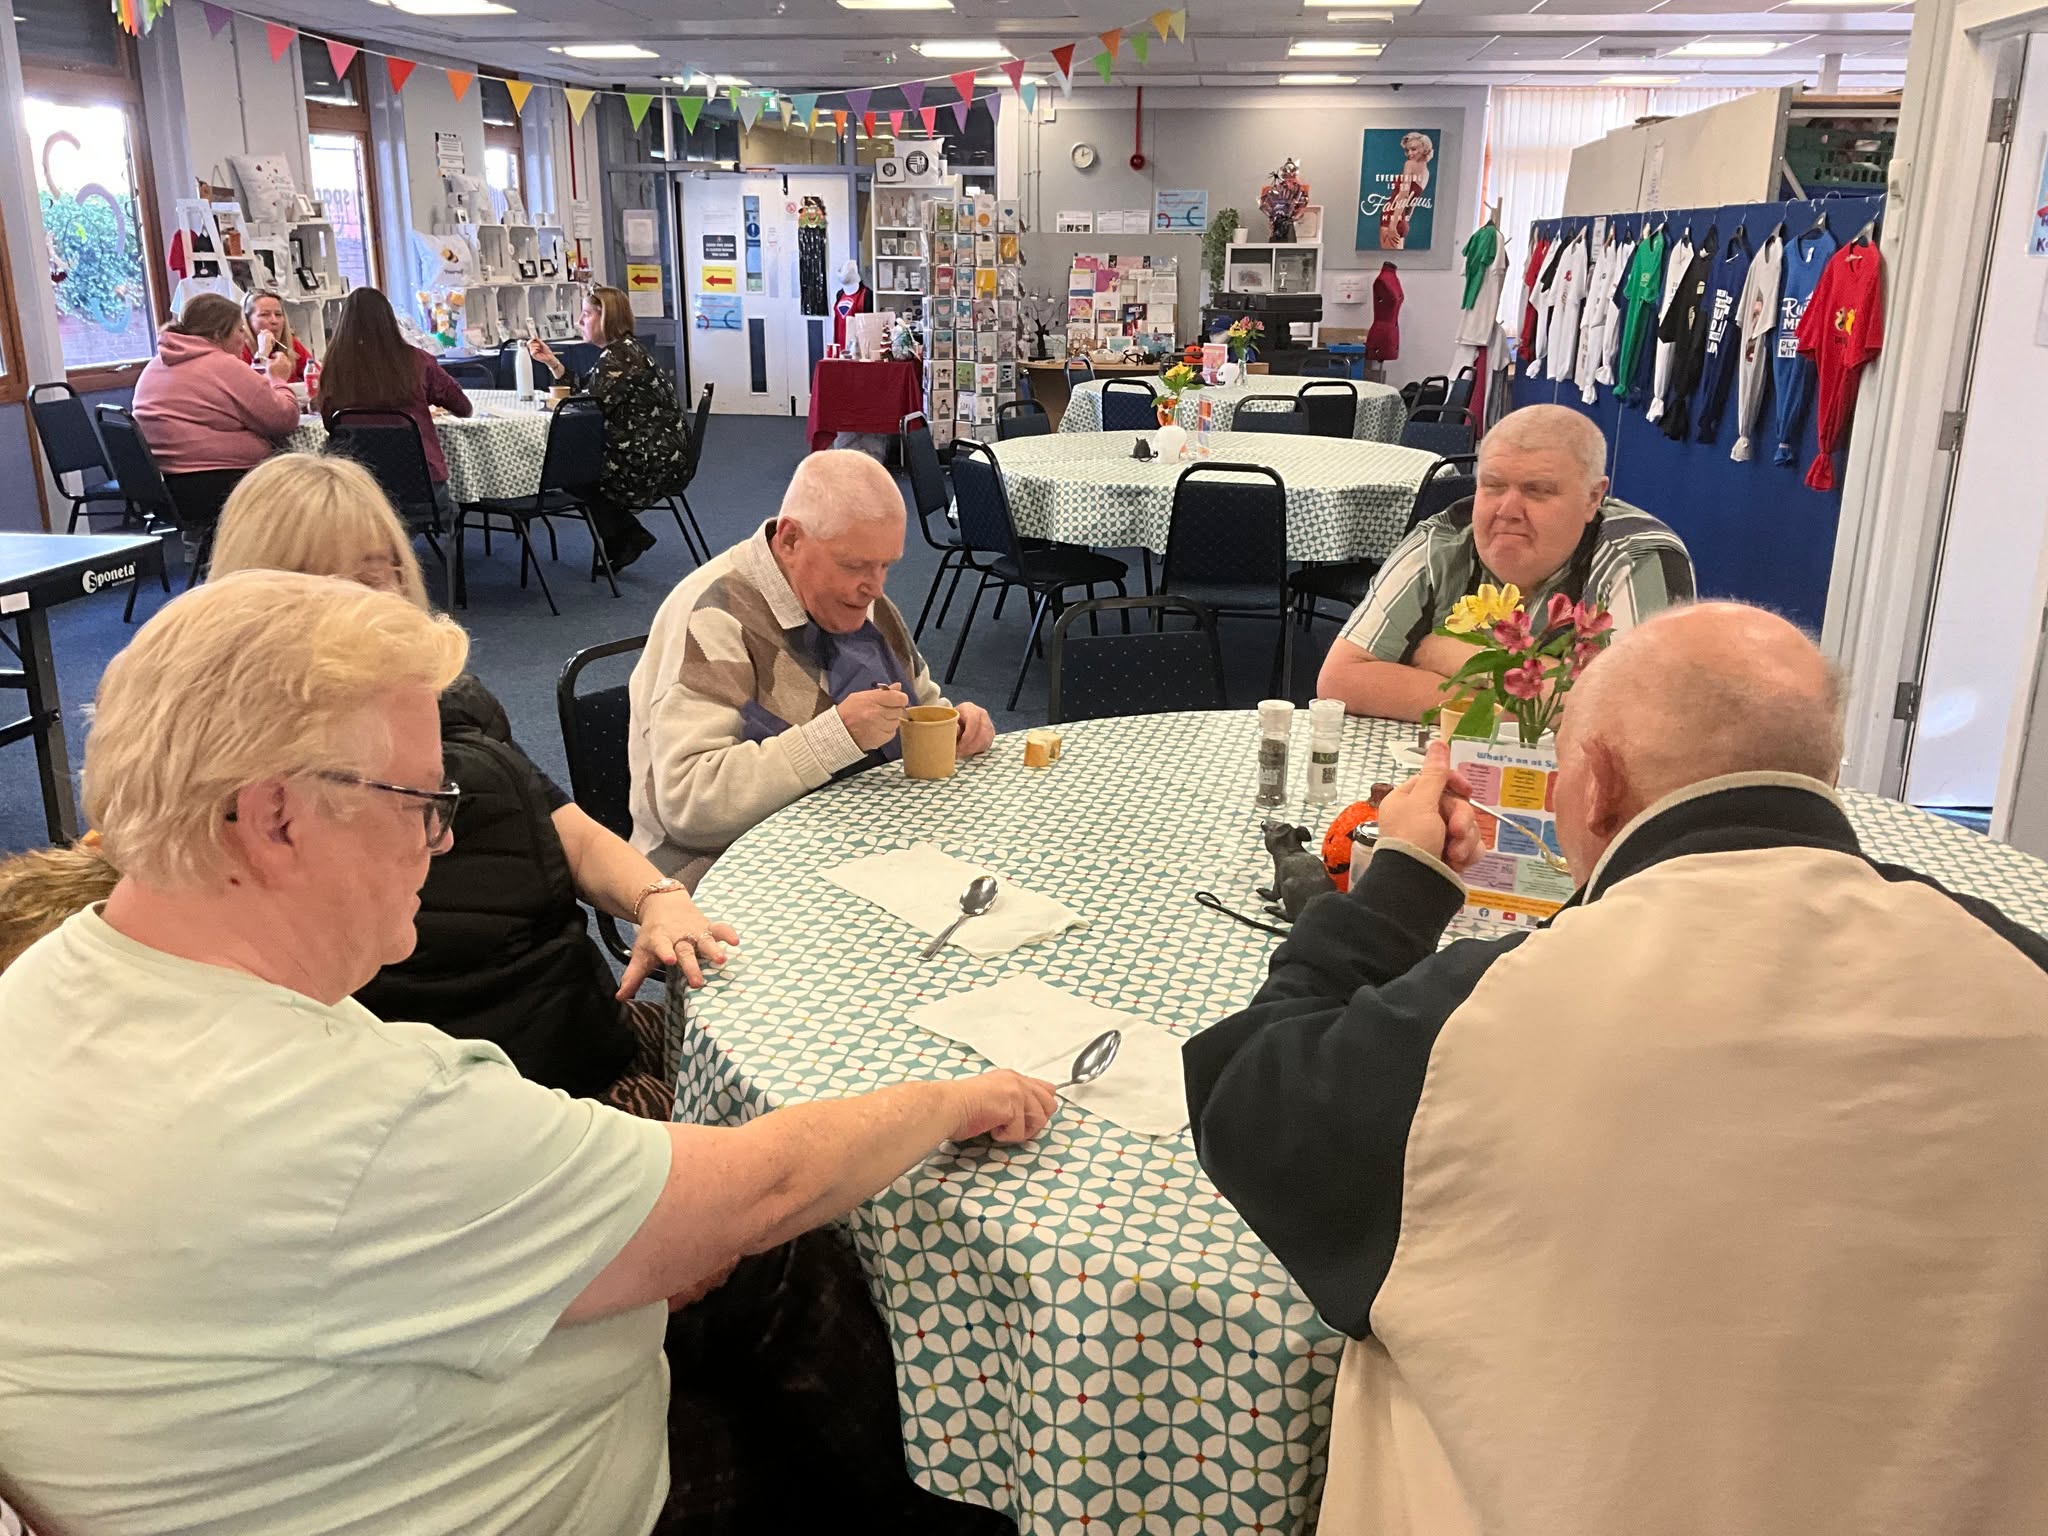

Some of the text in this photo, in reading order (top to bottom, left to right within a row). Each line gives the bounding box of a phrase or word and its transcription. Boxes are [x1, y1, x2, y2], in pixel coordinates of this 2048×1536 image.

[1375, 174, 1421, 182] EVERYTHING
[1360, 190, 1432, 216] Fabulous
[1780, 340, 1797, 348] PLA
[1780, 348, 1795, 356] WIT
[82, 564, 135, 594] Sponeta
[1476, 751, 1513, 763] What's
